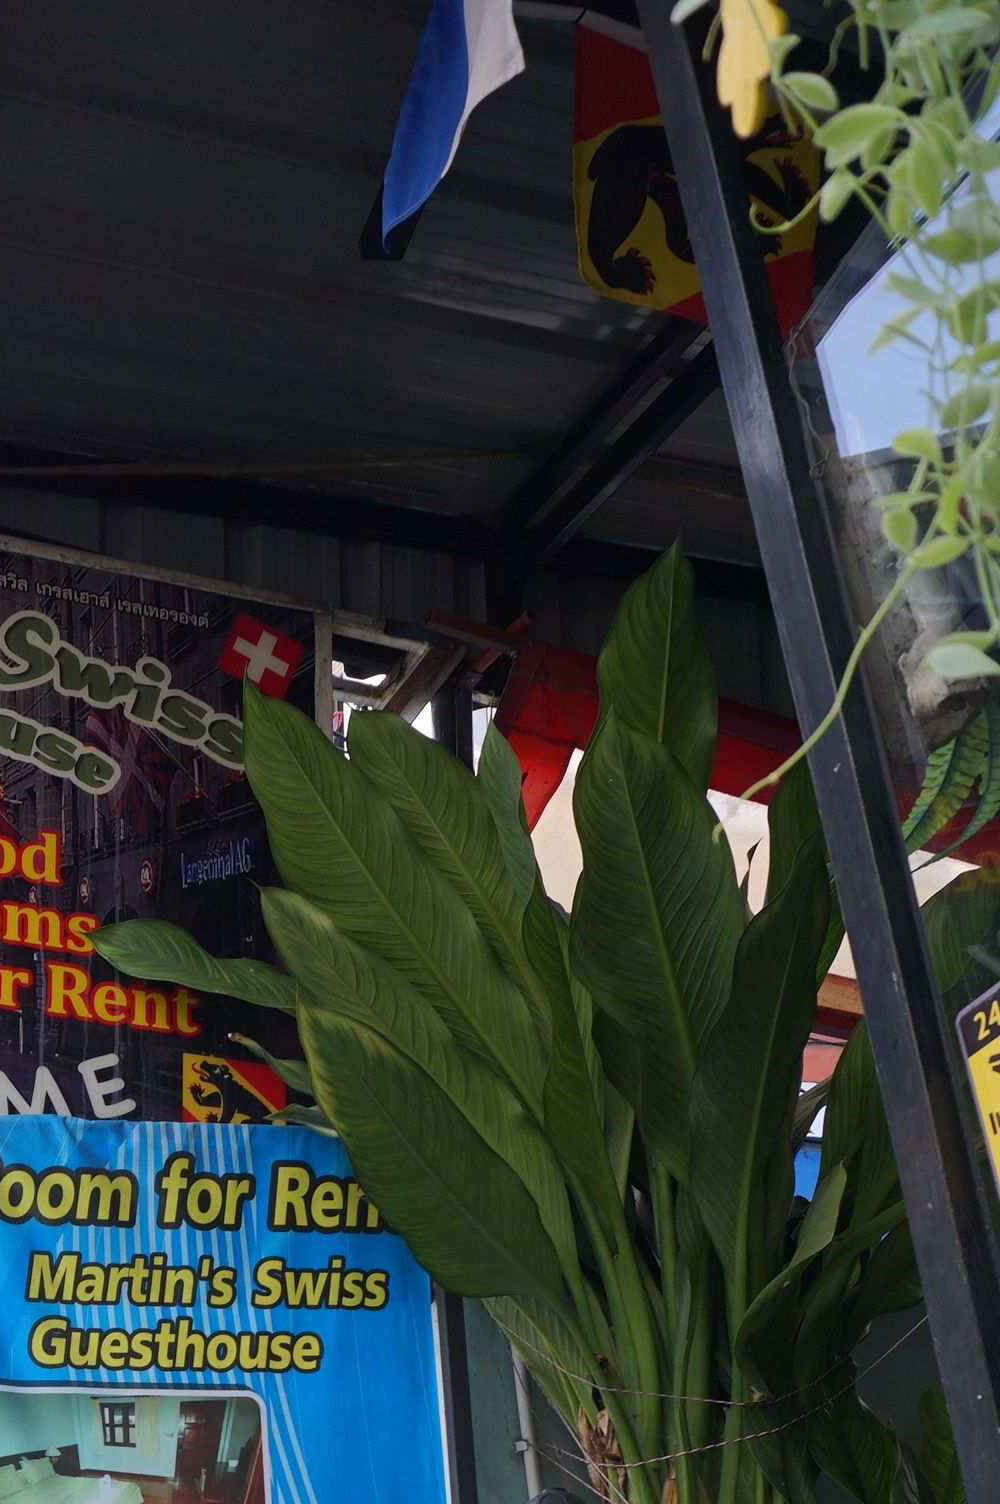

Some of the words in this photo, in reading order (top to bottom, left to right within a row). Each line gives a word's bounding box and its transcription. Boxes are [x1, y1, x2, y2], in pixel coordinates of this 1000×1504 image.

[45, 961, 200, 1036] Rent
[160, 1154, 252, 1227] for
[270, 1163, 382, 1231] Ren
[28, 1252, 235, 1306] Martin's
[253, 1257, 388, 1308] Swiss
[30, 1316, 322, 1371] Guesthouse
